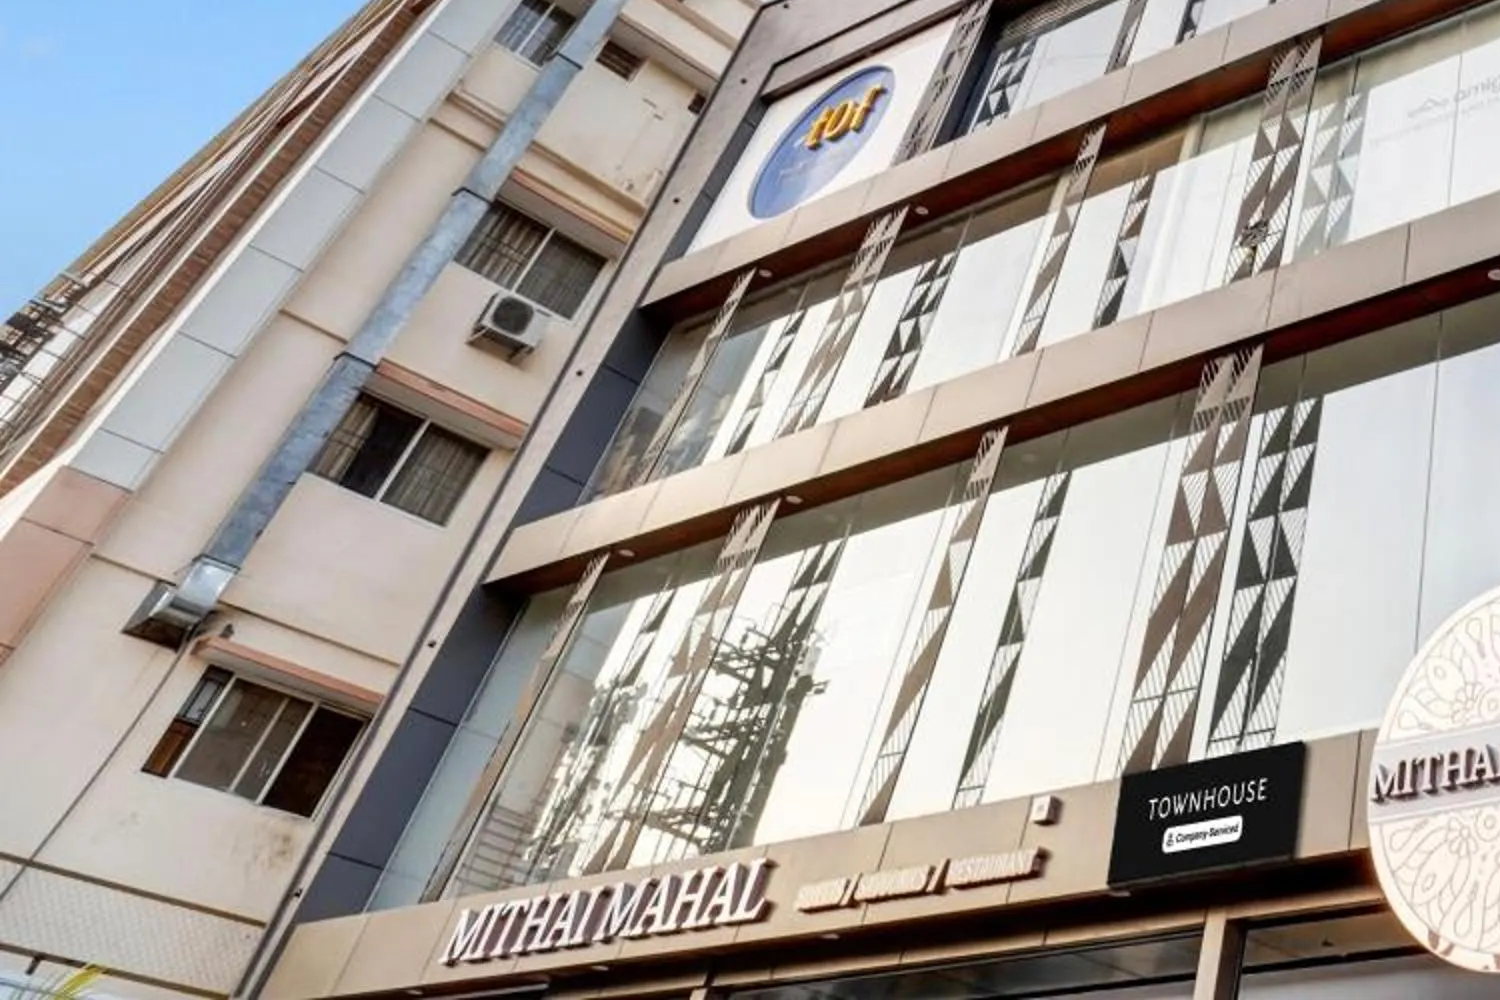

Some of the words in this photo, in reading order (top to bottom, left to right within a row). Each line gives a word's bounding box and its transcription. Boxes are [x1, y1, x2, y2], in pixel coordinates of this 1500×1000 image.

[1149, 778, 1268, 820] TOWNHOUSE
[438, 884, 606, 966] MITHAI
[592, 858, 774, 942] MAHAL
